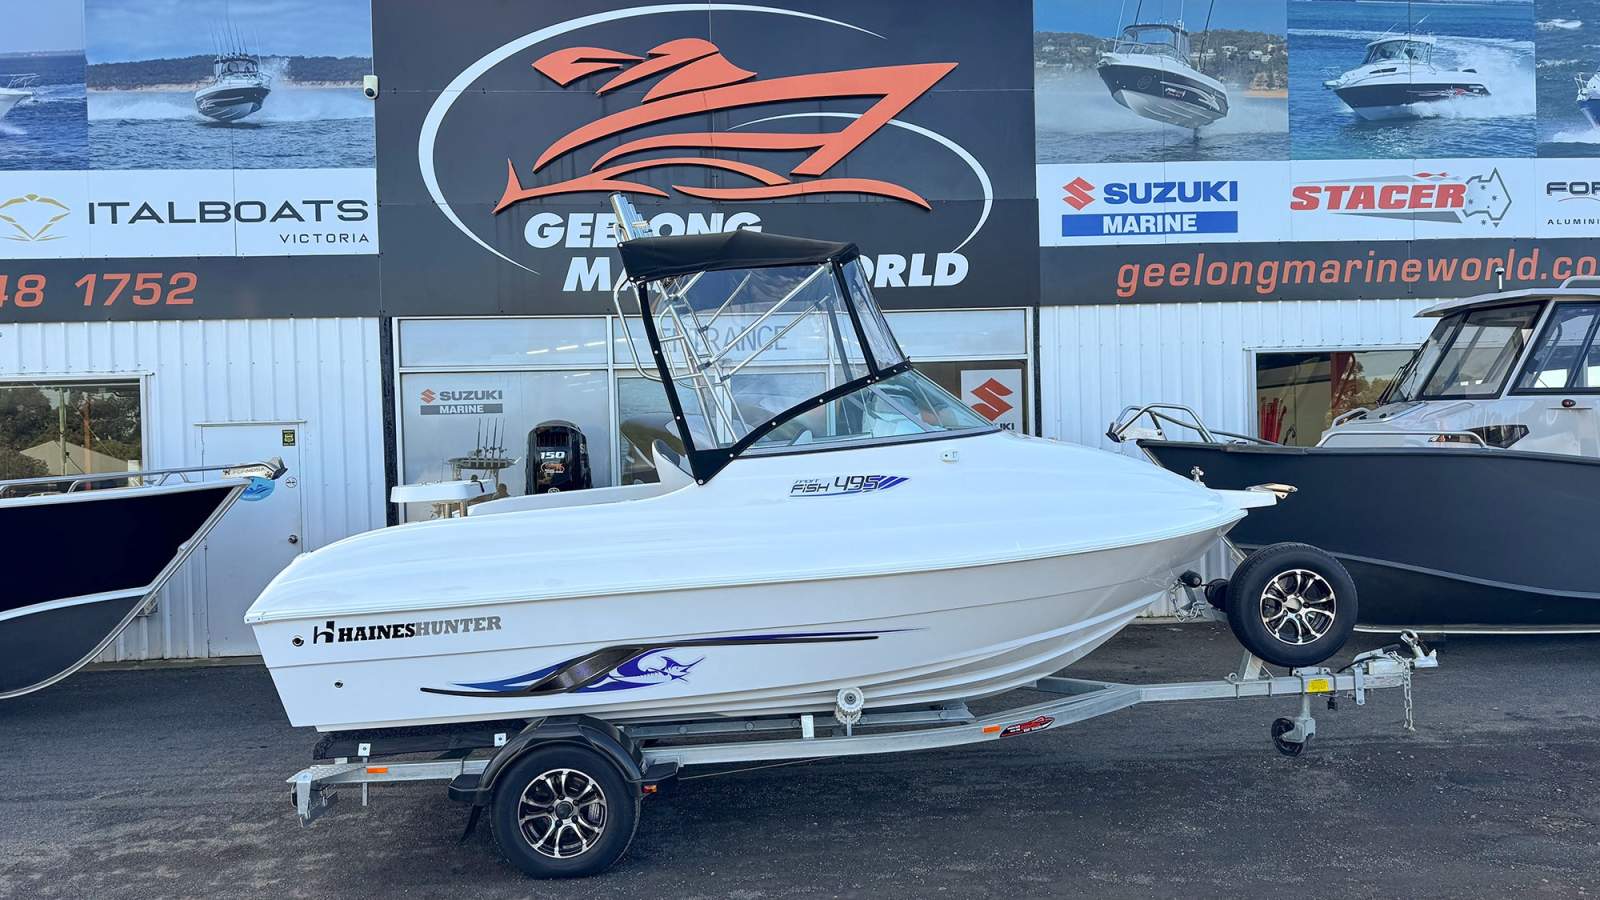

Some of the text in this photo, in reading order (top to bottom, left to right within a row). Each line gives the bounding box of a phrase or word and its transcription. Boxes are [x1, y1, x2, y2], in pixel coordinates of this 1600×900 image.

[1104, 180, 1238, 205] SUZUKI
[1290, 183, 1466, 210] STACER
[88, 200, 369, 225] ITALBOATS
[1103, 213, 1197, 234] MARINE
[279, 233, 370, 244] VICTORIA
[524, 212, 763, 248] GEEONG
[859, 252, 969, 288] RLD
[0, 272, 198, 308] 8 1752
[439, 390, 503, 401] SUZUKI
[439, 405, 484, 414] MARINE
[540, 451, 566, 459] 150
[834, 475, 881, 491] 495
